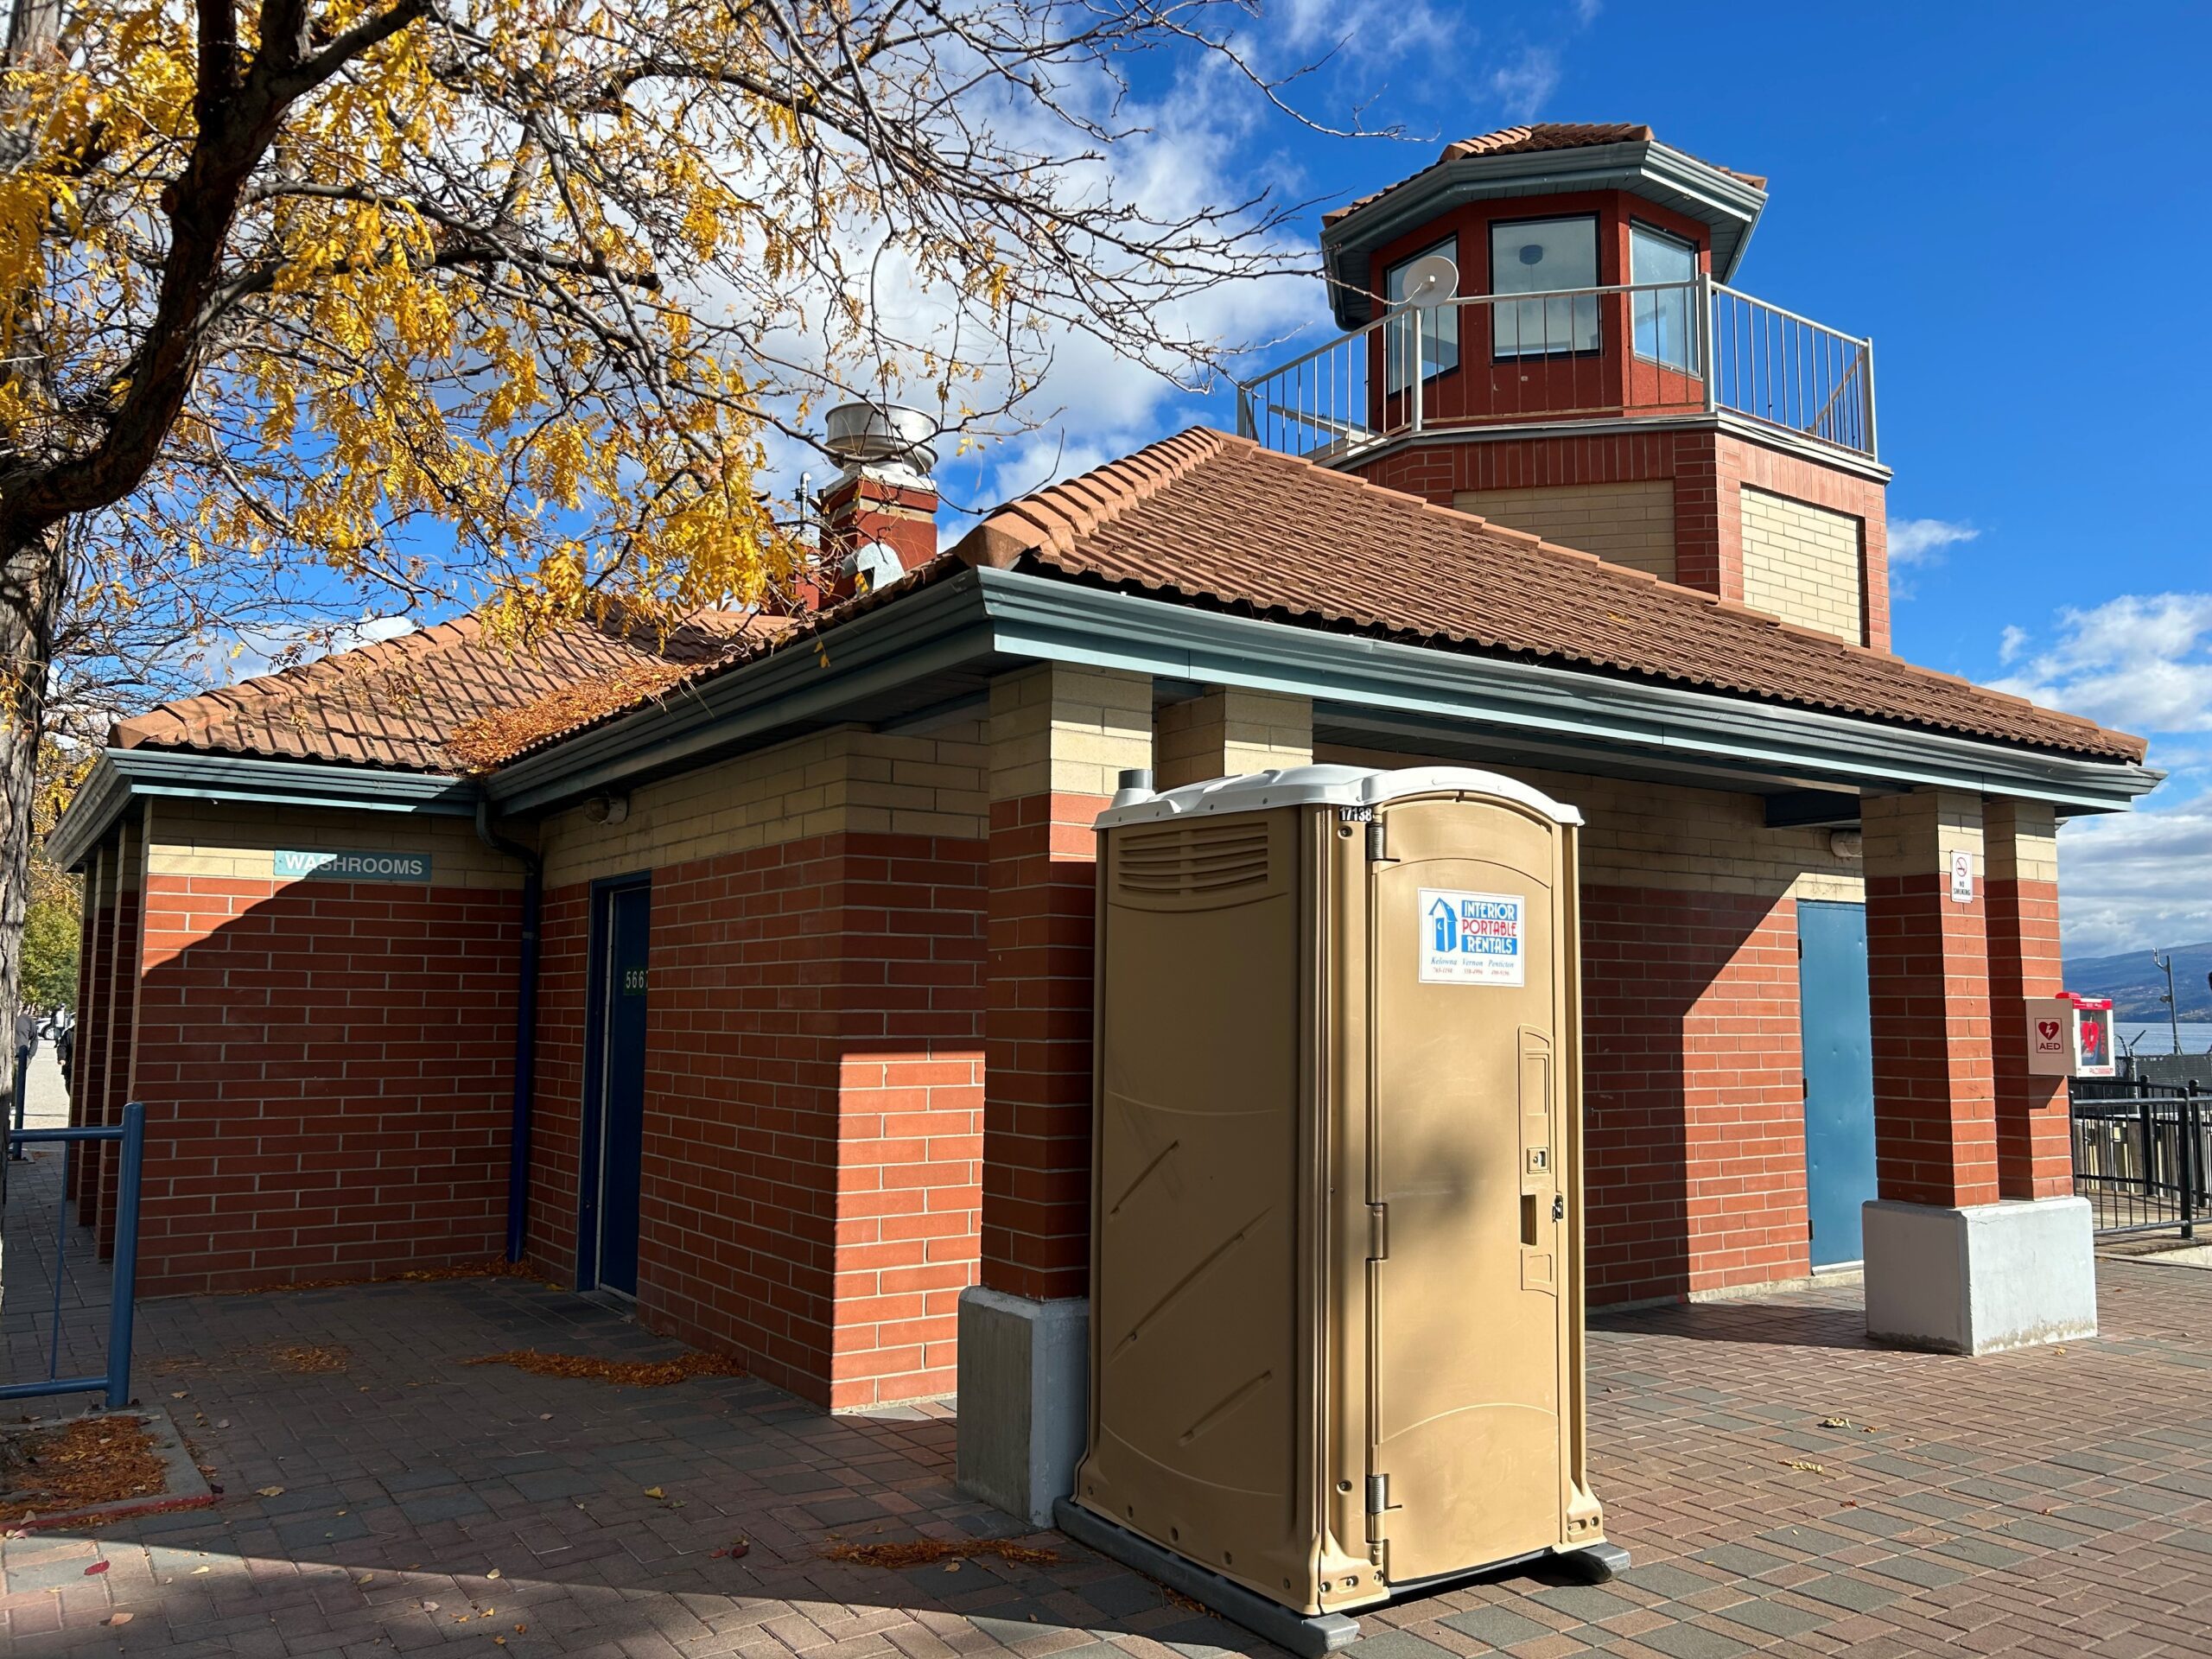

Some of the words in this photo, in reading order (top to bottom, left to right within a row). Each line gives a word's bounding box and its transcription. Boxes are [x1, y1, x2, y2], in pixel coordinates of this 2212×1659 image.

[1339, 805, 1372, 822] 17138
[284, 854, 423, 875] WASHROOMS
[1953, 887, 1971, 896] SMOKING
[1463, 900, 1515, 921] INTERIOR
[1461, 918, 1517, 937] PORTABLE
[1466, 936, 1513, 954] RENTALS
[1430, 957, 1458, 966] Kelowna
[1462, 957, 1484, 967] Vernon
[1488, 959, 1514, 969] Penticton
[2039, 1042, 2061, 1051] AED
